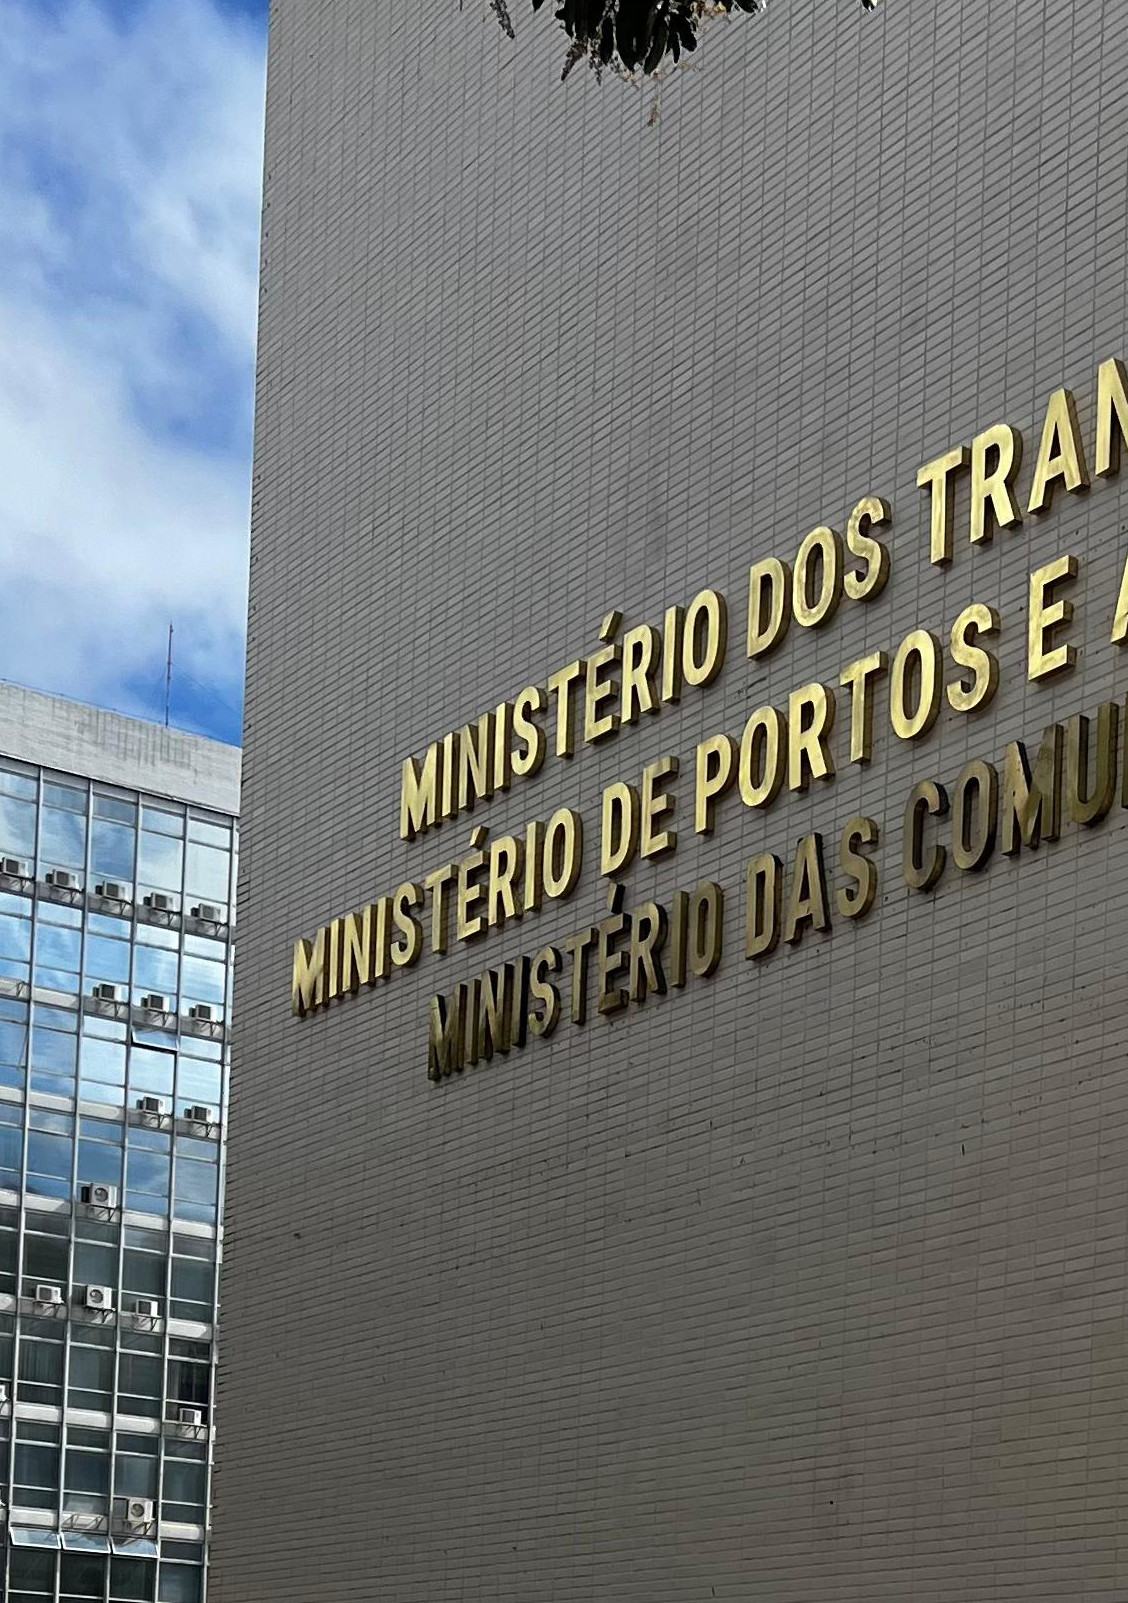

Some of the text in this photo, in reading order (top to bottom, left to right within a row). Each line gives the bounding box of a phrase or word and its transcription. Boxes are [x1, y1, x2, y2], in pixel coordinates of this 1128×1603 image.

[291, 807, 582, 1018] MINISTÉRIO
[600, 755, 679, 878] DE
[695, 602, 1000, 835] PORTOS
[1028, 555, 1078, 682] E
[400, 588, 728, 841] MINISTÉRIO
[746, 496, 892, 661] DOS
[427, 883, 723, 1081] MINISTÉRIO
[746, 816, 878, 961] DAS
